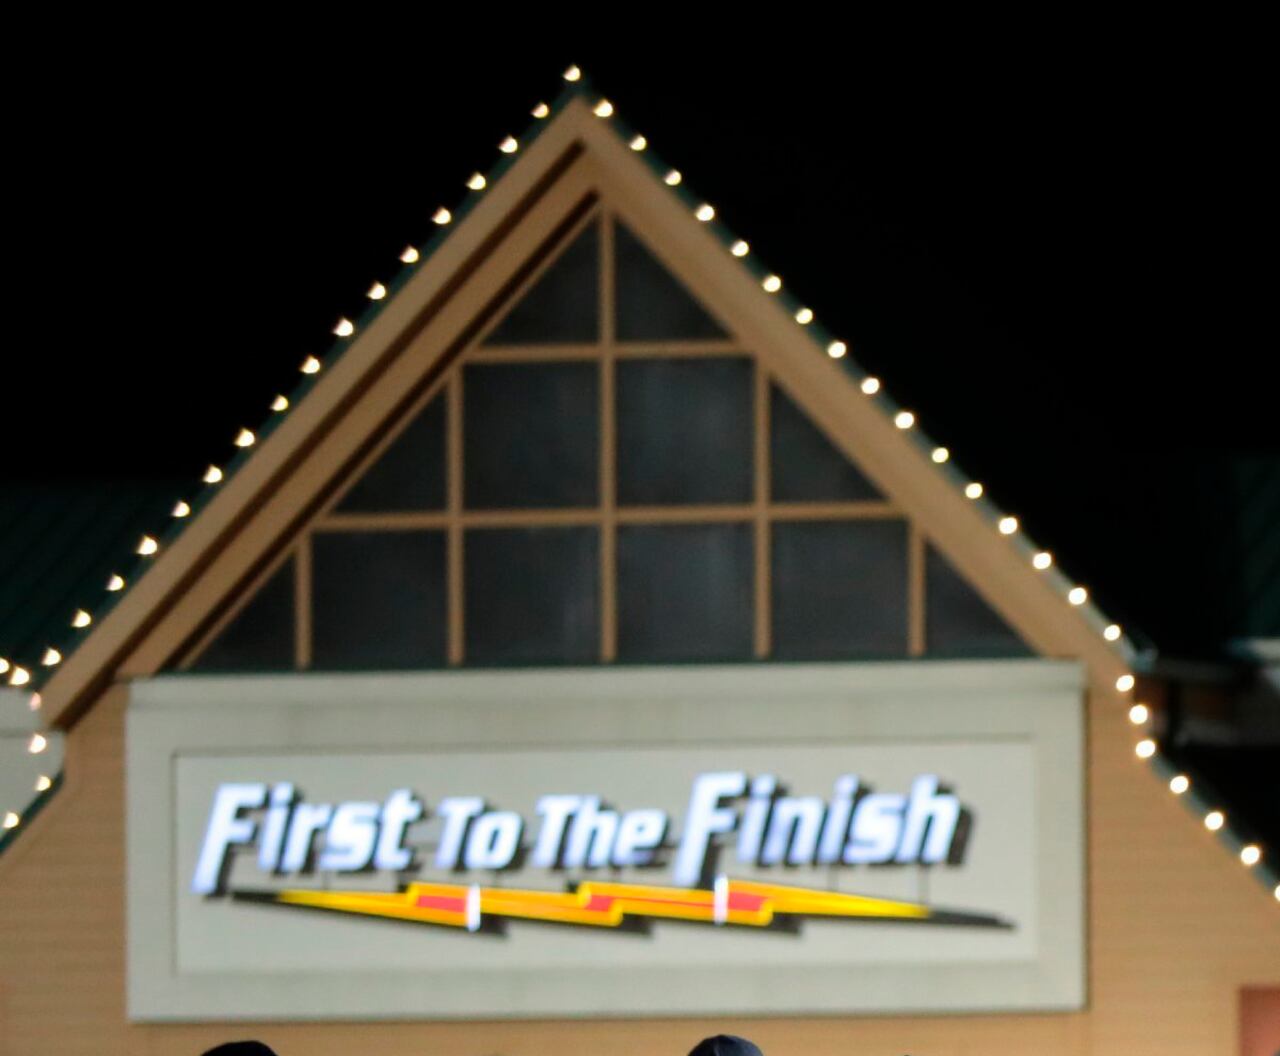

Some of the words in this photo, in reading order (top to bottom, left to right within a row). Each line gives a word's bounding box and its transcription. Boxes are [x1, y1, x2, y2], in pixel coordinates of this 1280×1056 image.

[189, 783, 419, 894] First
[434, 798, 521, 870] To
[533, 795, 667, 866] The
[672, 771, 962, 888] Finish
